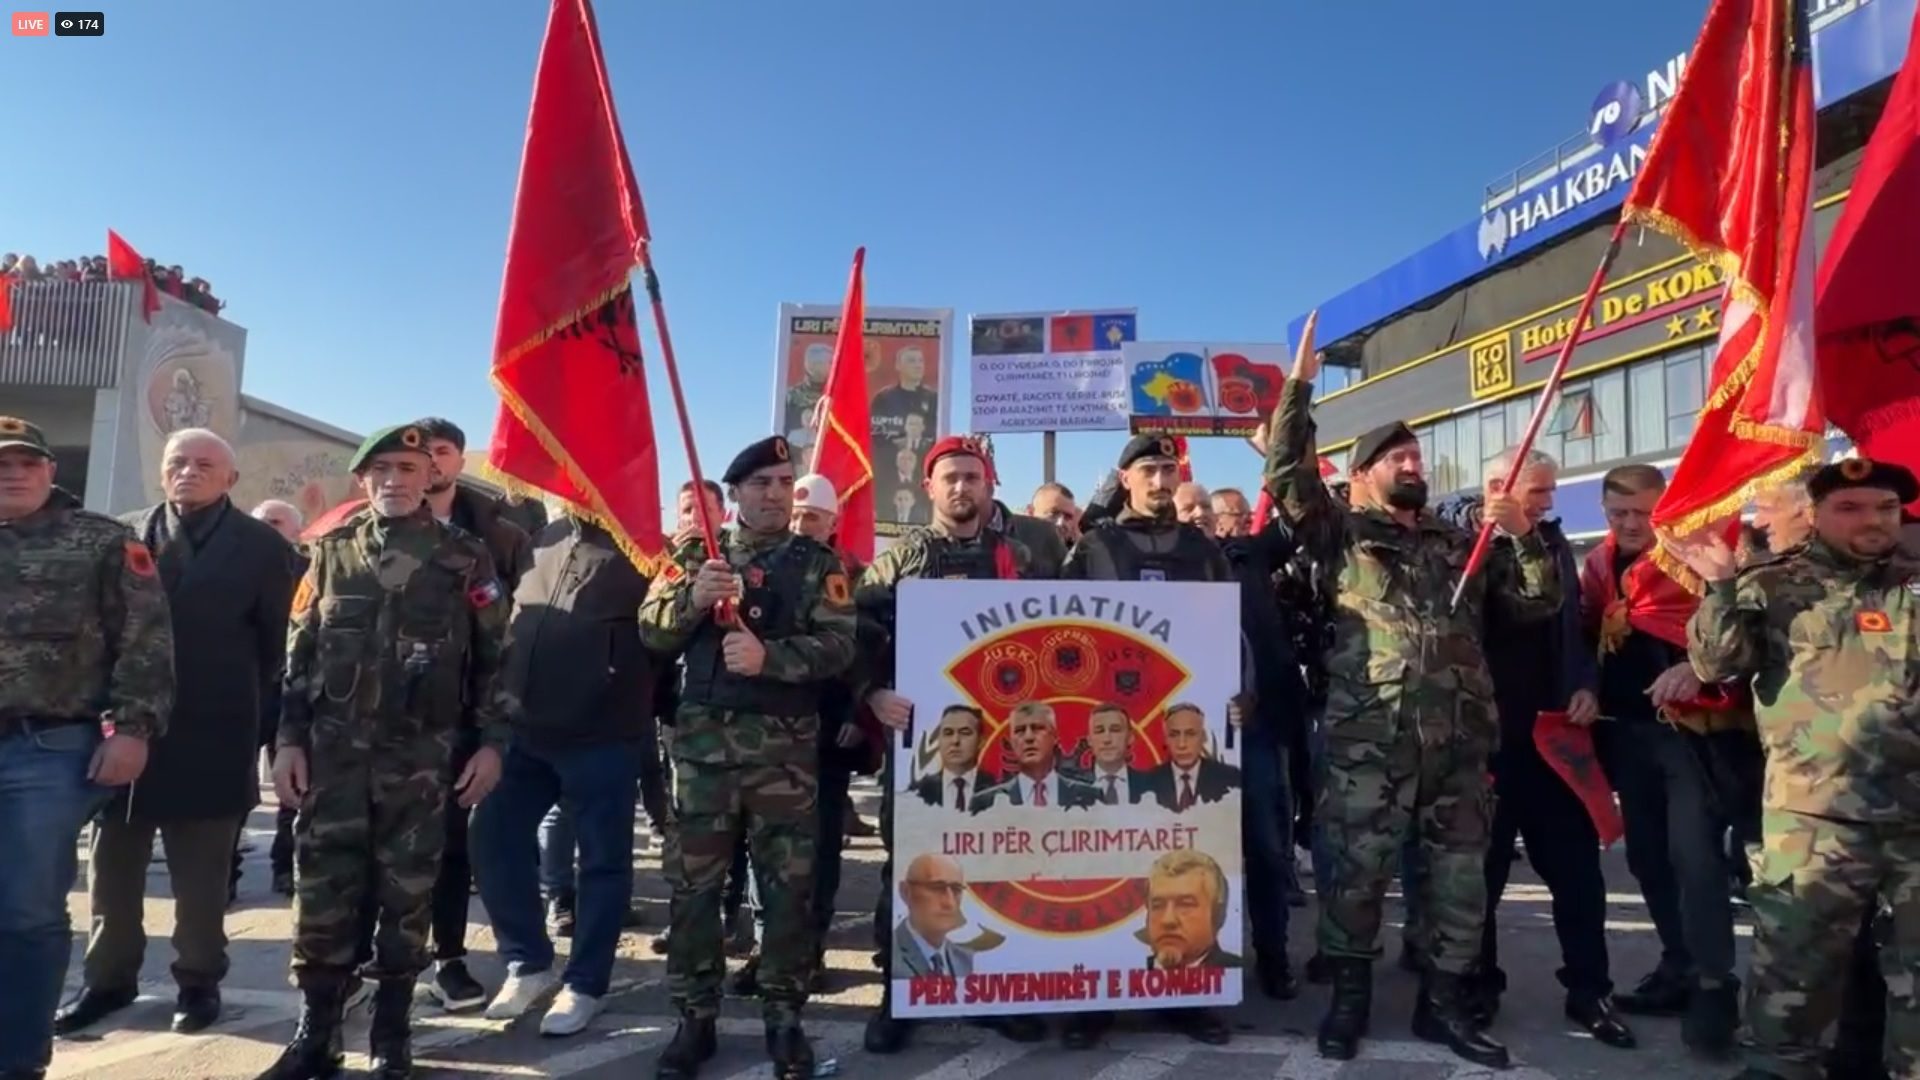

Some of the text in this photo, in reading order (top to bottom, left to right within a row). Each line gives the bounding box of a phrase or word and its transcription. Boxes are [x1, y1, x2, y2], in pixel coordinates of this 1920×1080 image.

[1510, 133, 1655, 238] HALKBAN
[1602, 293, 1643, 324] De
[1646, 262, 1728, 309] KOK
[862, 321, 941, 337] LIRIMTARËT
[1476, 343, 1504, 365] KO
[1477, 364, 1506, 386] KA
[960, 594, 1172, 643] INICIATIVA
[942, 823, 1199, 856] LIRI PËR ÇLIRIMTARËT
[964, 963, 1101, 1003] SUVENIRËT
[1107, 971, 1121, 997] E
[1129, 968, 1226, 996] KOMBIT
